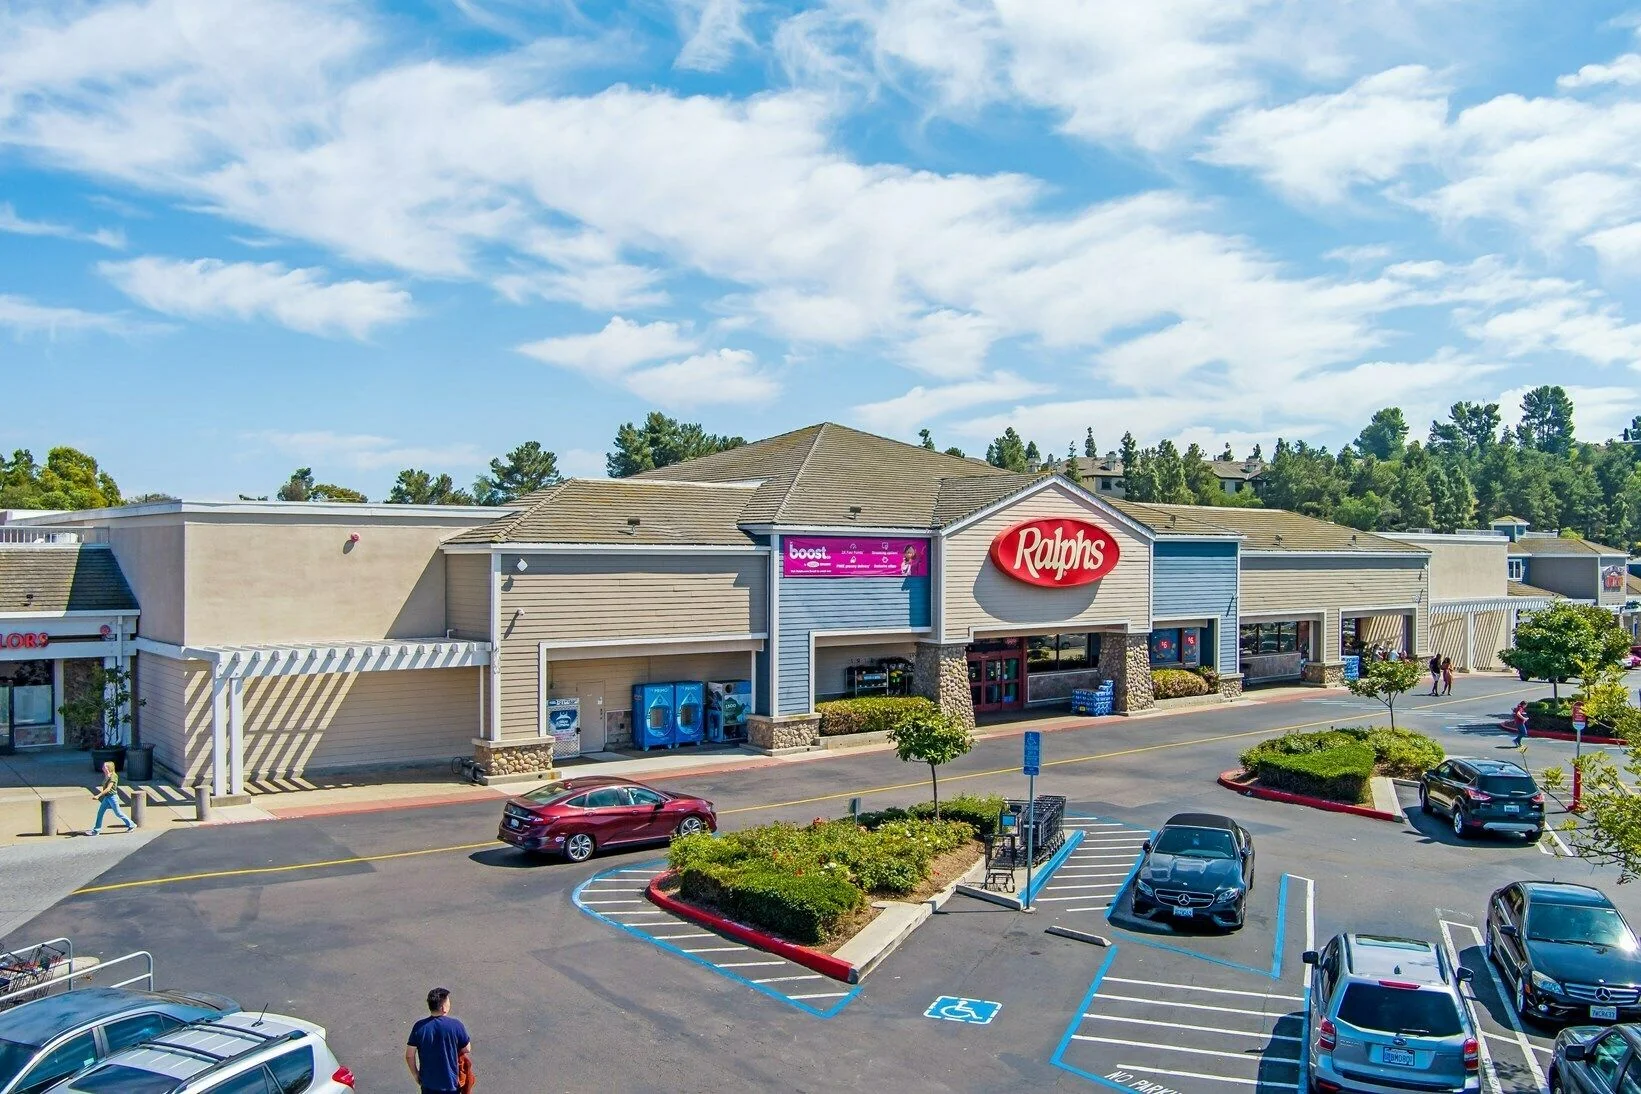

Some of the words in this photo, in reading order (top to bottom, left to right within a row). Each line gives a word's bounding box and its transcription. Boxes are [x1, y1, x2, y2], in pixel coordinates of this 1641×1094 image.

[789, 541, 828, 560] boost
[1013, 526, 1106, 581] Ralphs
[1104, 1070, 1134, 1083] NO
